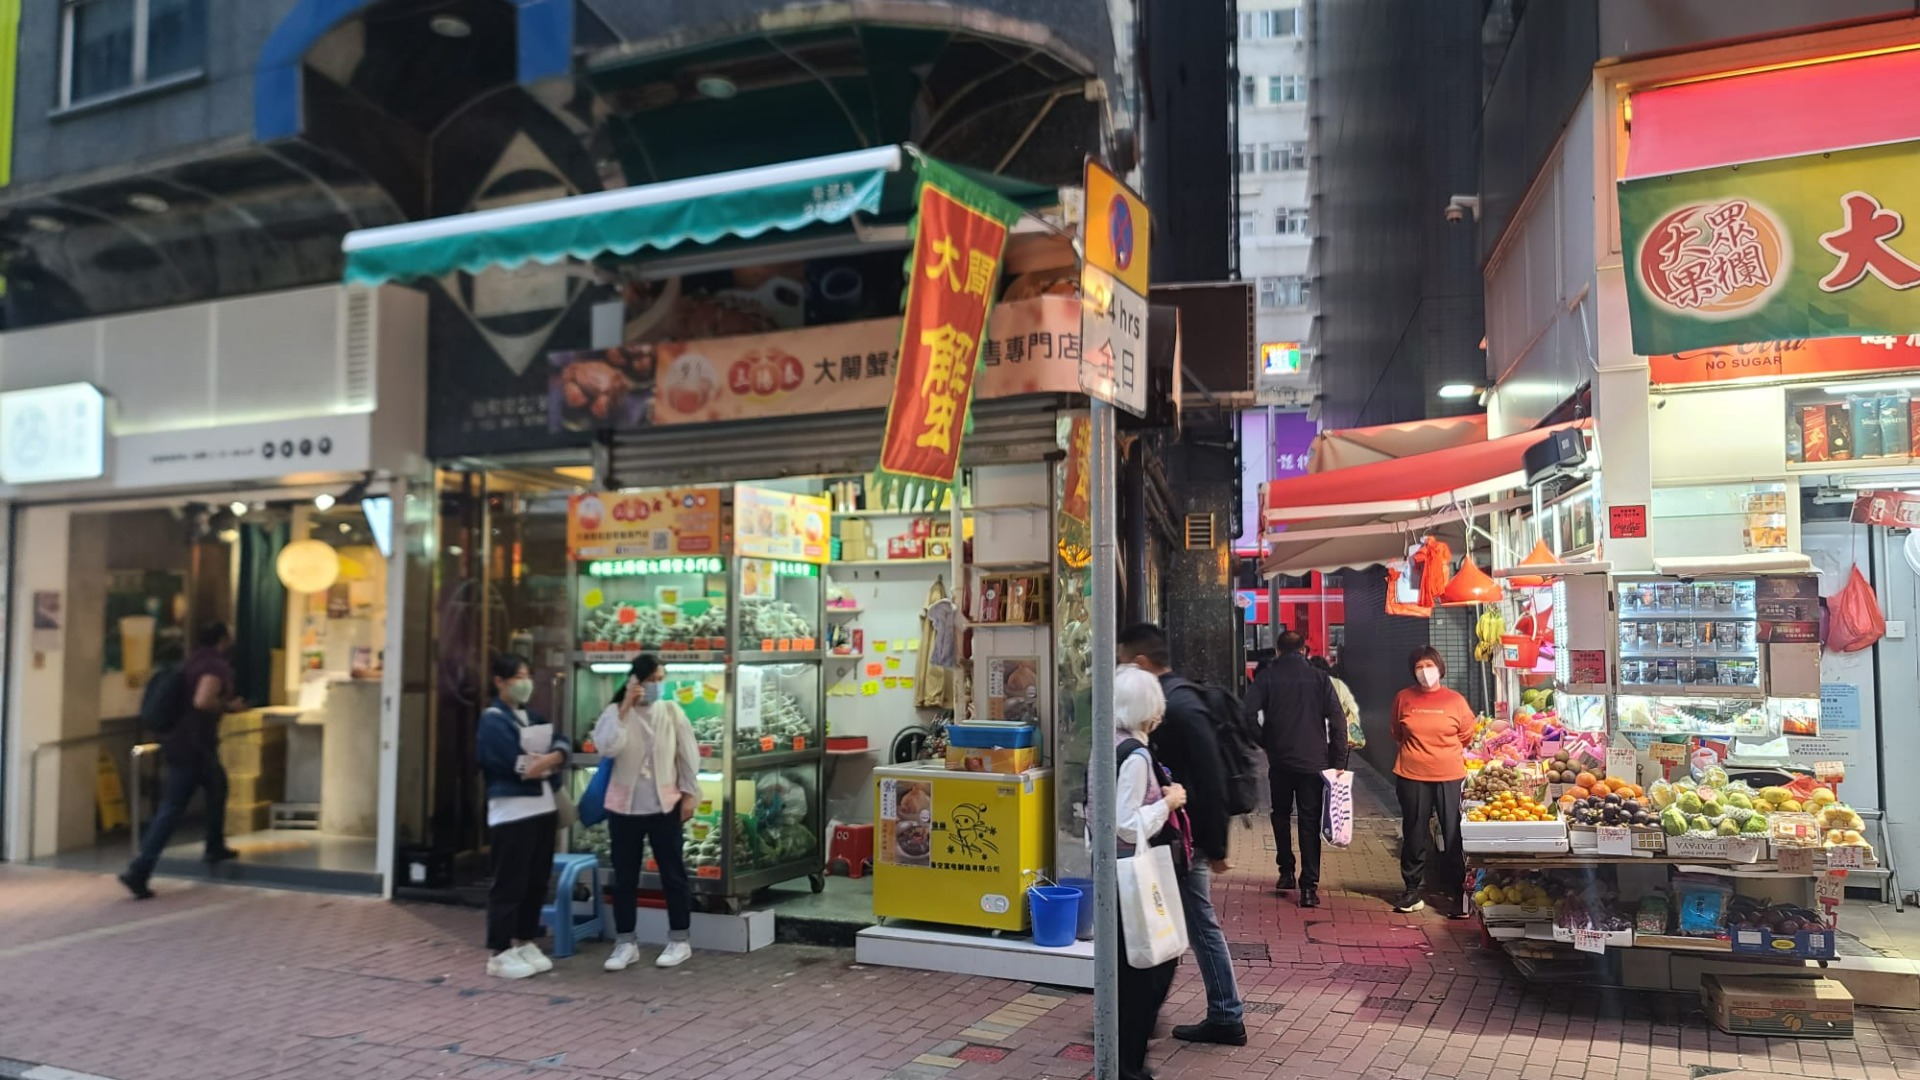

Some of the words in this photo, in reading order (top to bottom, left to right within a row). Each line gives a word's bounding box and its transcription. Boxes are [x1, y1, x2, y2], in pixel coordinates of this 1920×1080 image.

[1819, 191, 1920, 292] 大
[1093, 284, 1116, 324] 24
[1120, 299, 1140, 340] hrs
[814, 350, 899, 385] 大閘蟹
[1098, 338, 1135, 393] 全日
[1706, 360, 1726, 371] NO
[1731, 355, 1783, 369] SUGAR
